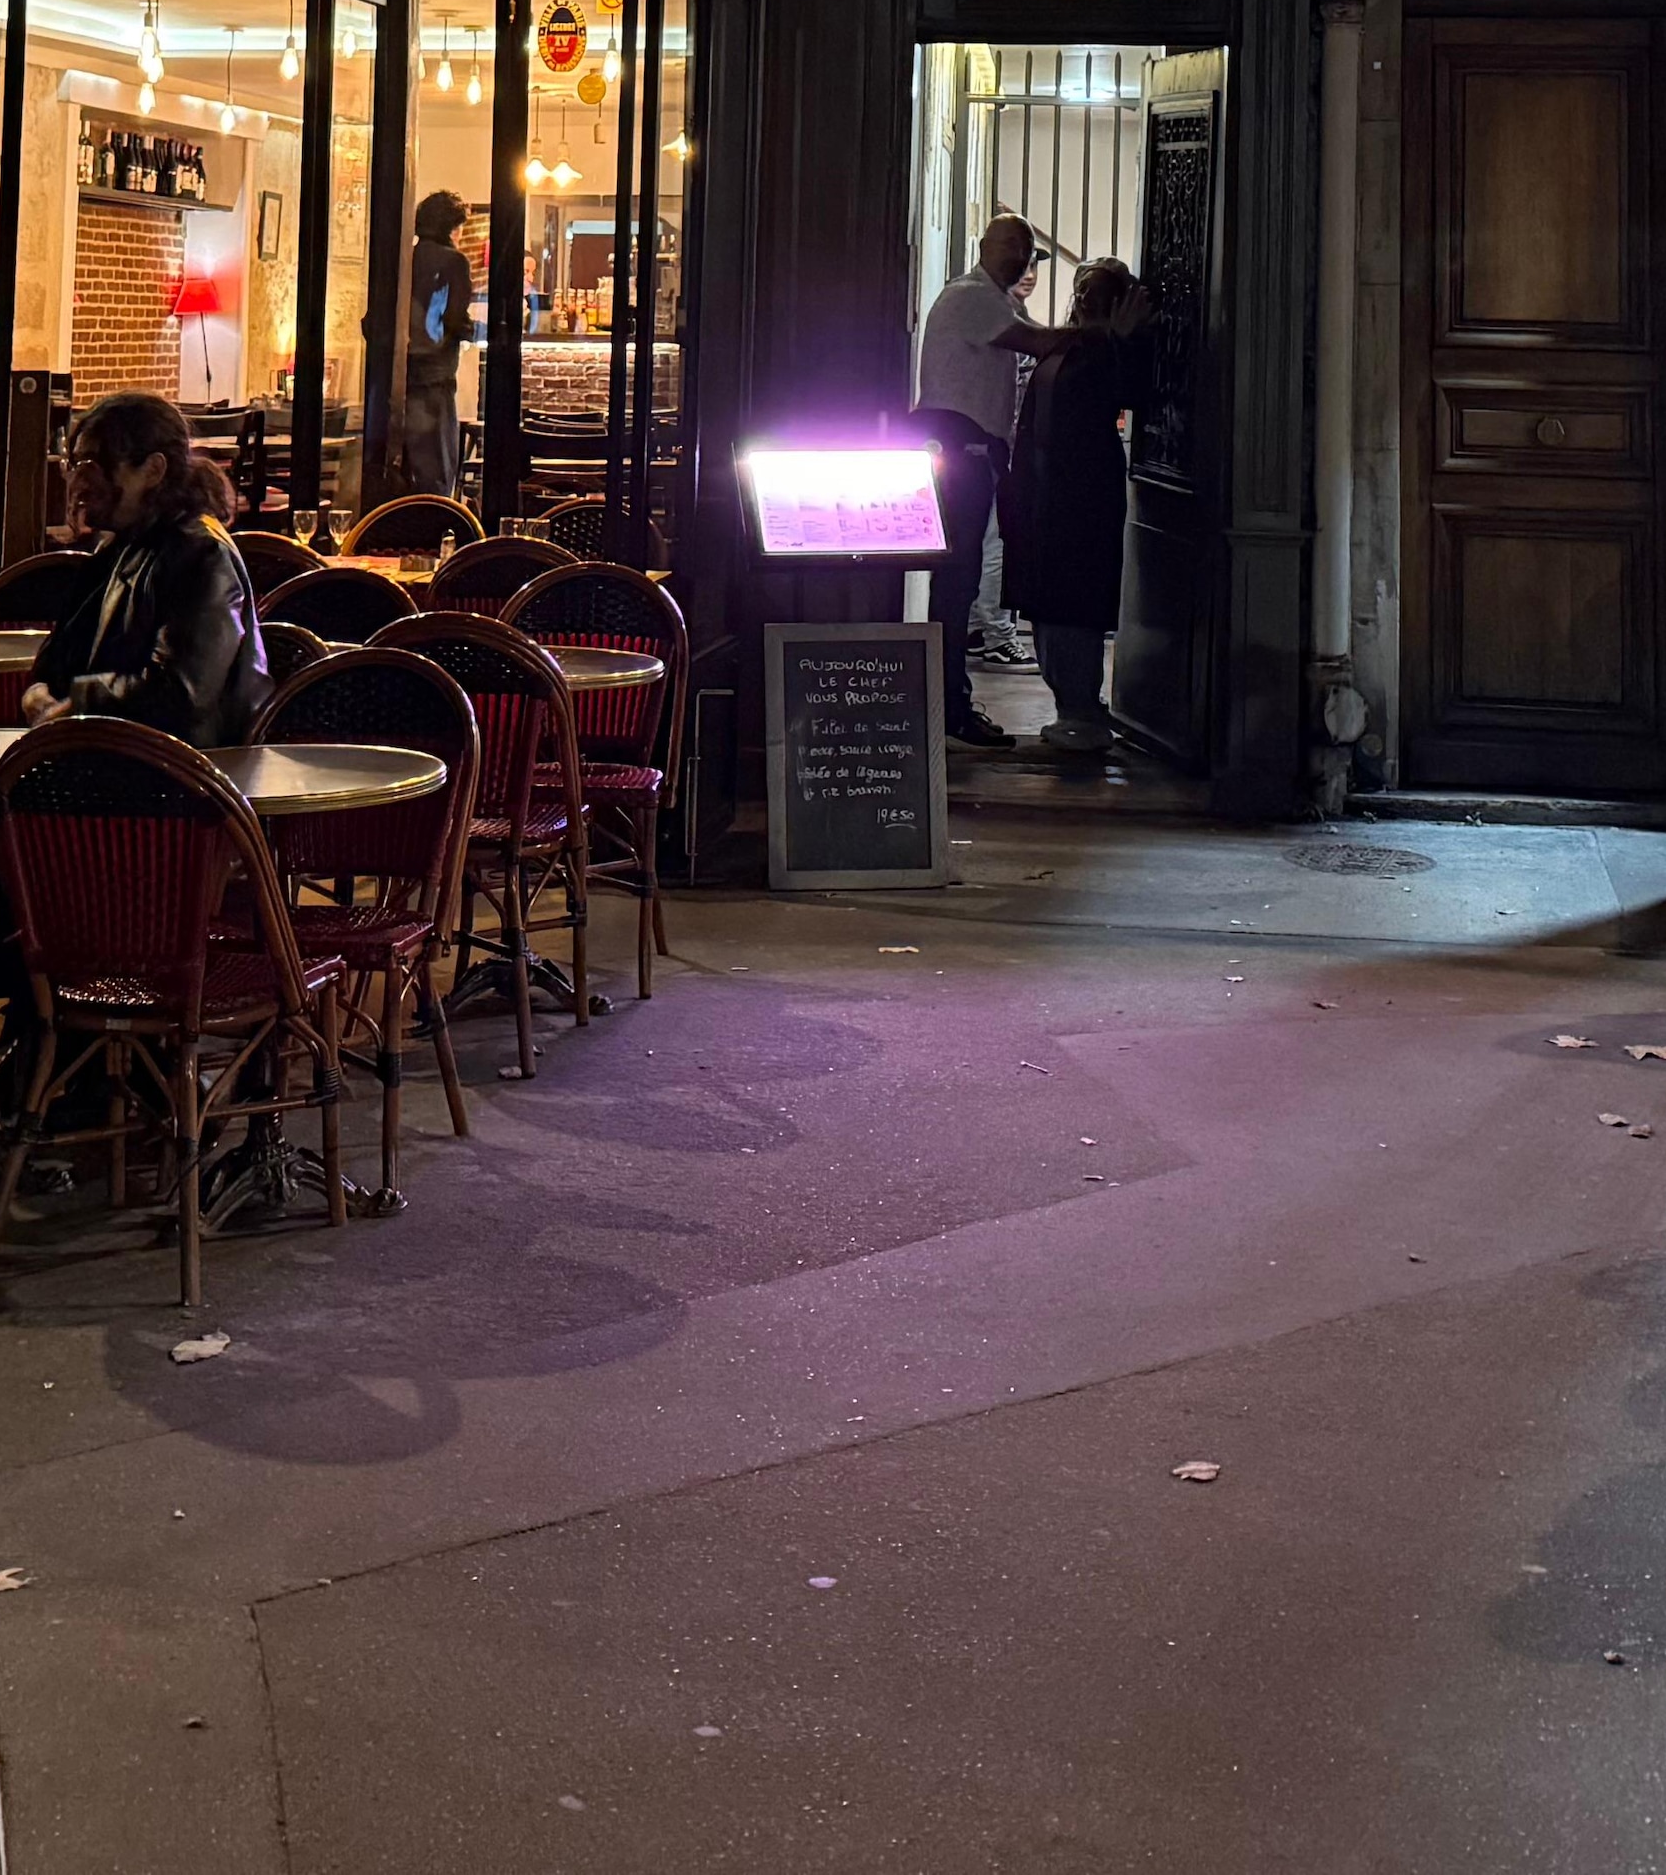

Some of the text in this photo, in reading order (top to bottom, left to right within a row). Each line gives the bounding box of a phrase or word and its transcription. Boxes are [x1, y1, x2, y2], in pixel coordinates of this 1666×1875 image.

[799, 658, 904, 672] AUJOURD'HUI
[819, 677, 892, 688] LE CHEF
[805, 690, 906, 706] VOUS PROPOSE
